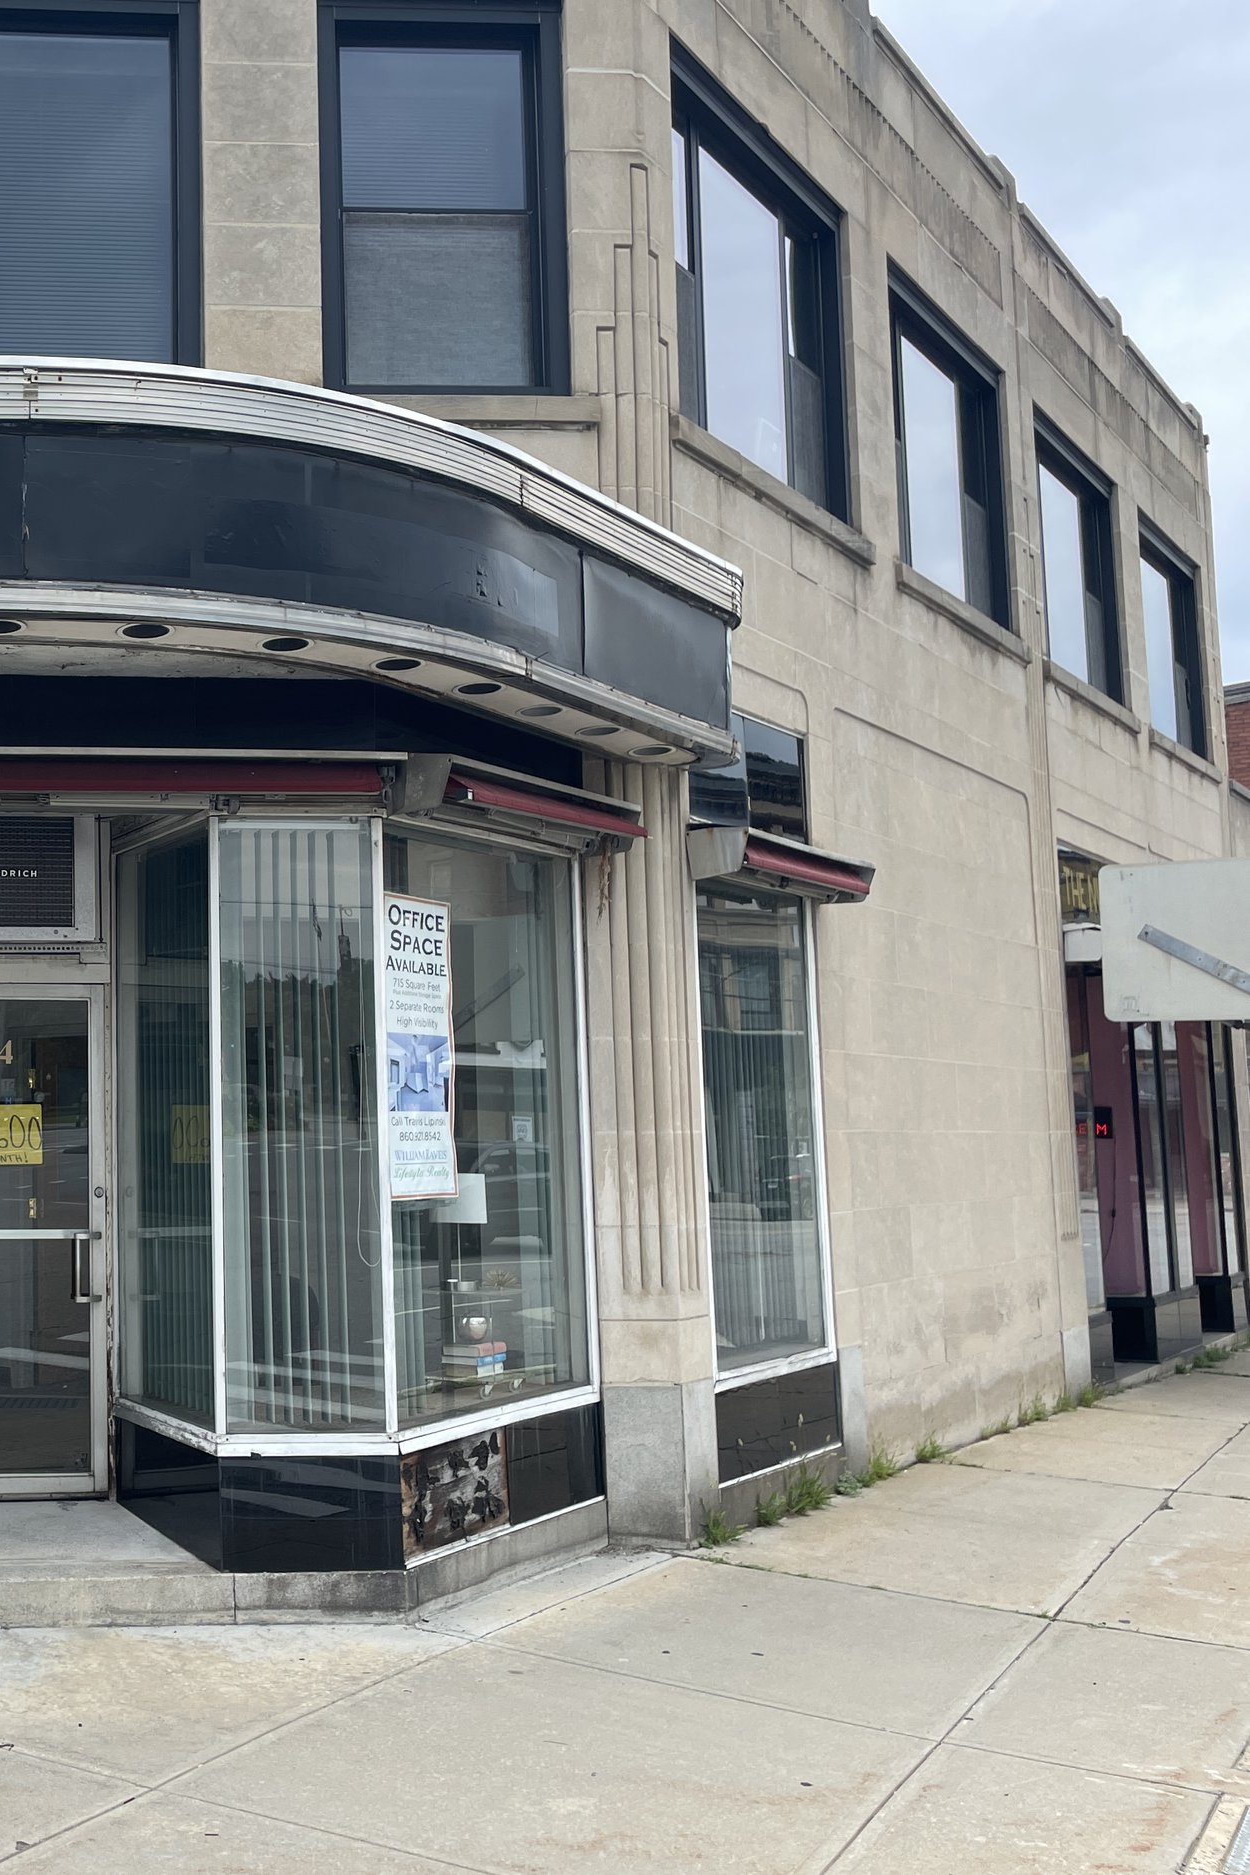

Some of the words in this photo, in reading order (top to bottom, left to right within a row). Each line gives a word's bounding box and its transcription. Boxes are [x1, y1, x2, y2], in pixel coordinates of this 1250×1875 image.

[1062, 866, 1087, 910] THE
[1087, 873, 1099, 913] N
[388, 904, 445, 933] OFFICE
[390, 930, 443, 957] SPACE
[385, 955, 447, 977] AVAILABLE
[393, 977, 405, 989] 715
[405, 979, 426, 991] Square
[389, 999, 395, 1010] 2
[395, 1000, 423, 1012] Separate
[423, 1003, 445, 1014] Rooms
[396, 1016, 413, 1028] High
[1096, 1123, 1107, 1135] M
